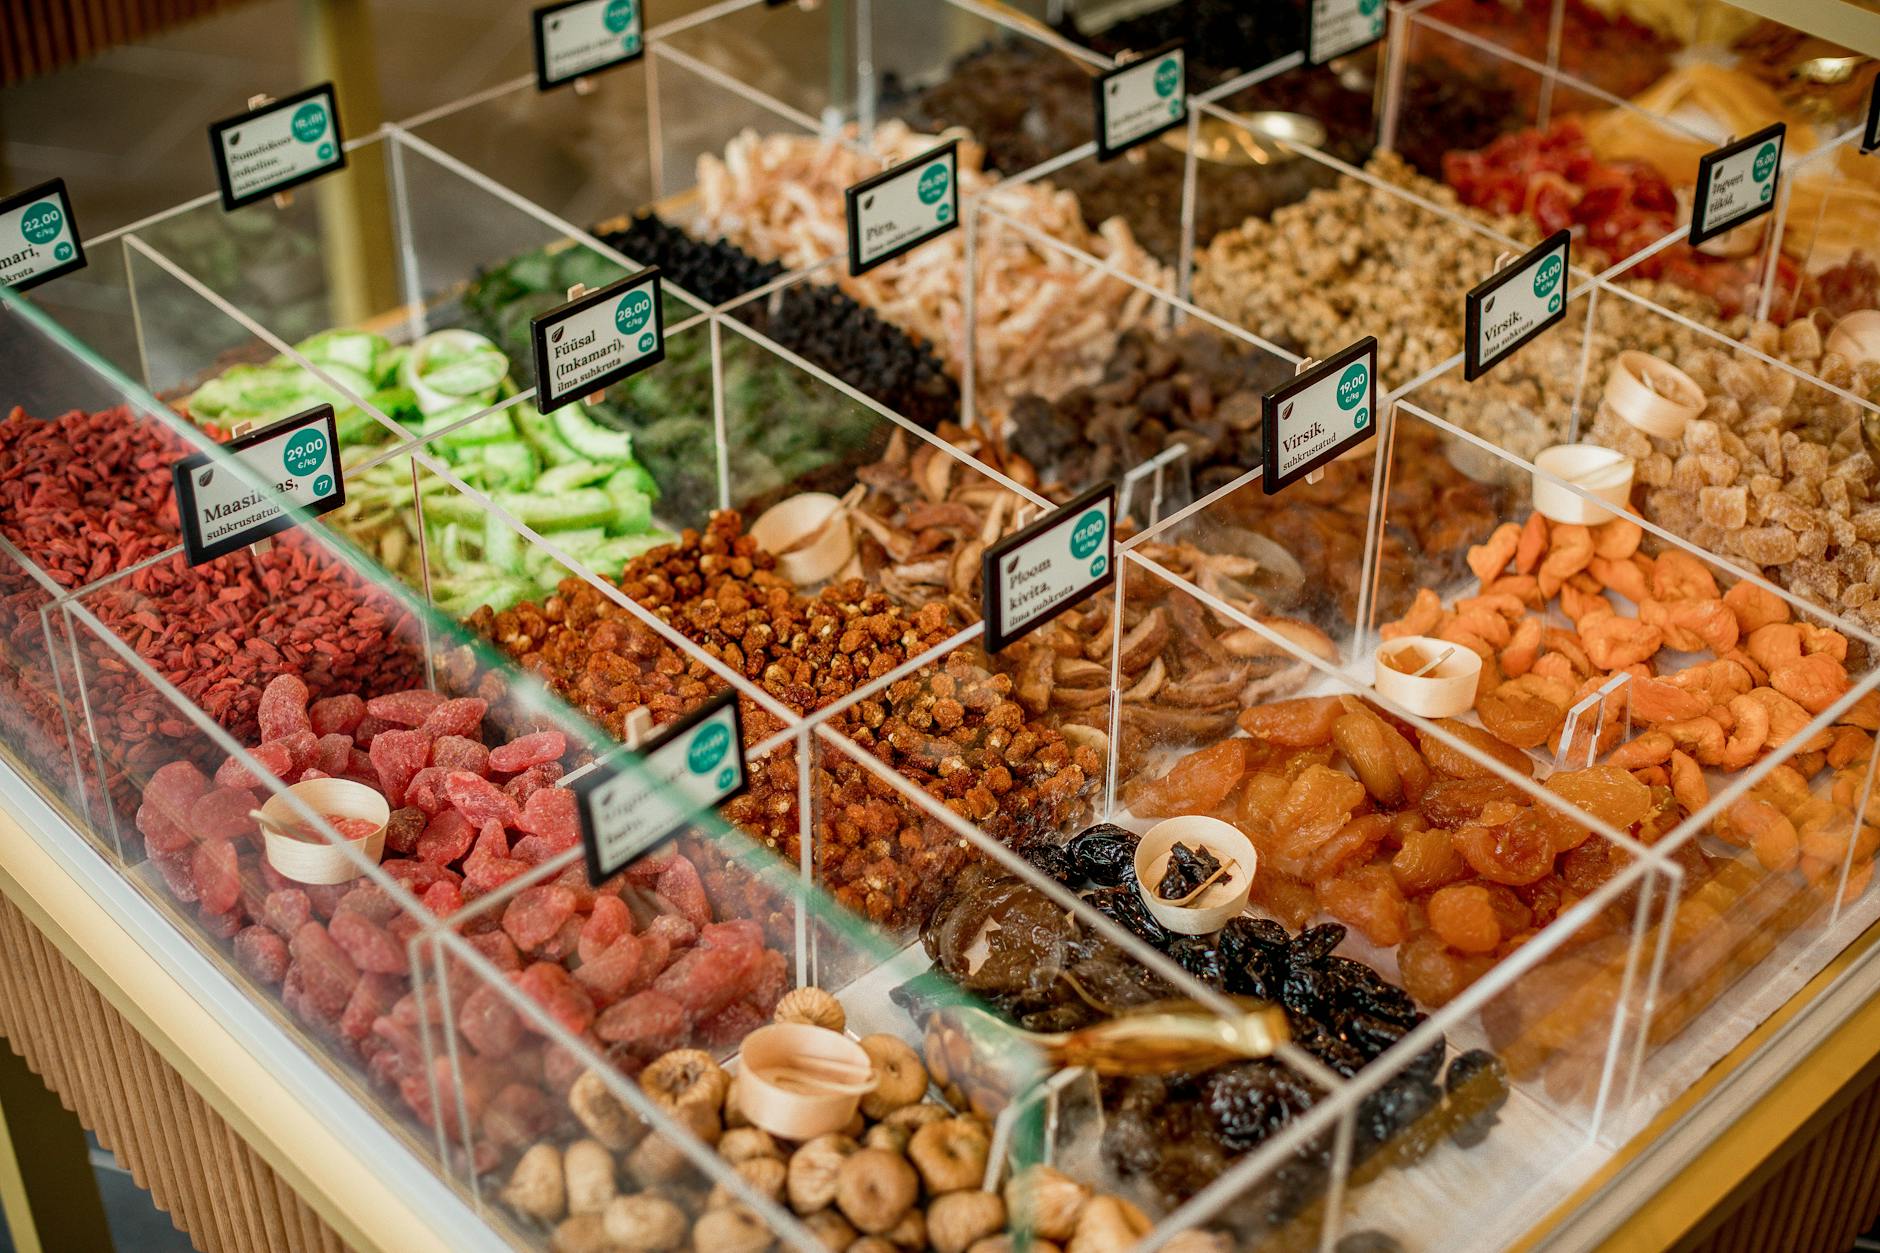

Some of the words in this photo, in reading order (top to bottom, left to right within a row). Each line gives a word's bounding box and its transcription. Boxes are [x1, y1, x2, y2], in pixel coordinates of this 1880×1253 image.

[554, 330, 596, 359] Füüsal
[557, 379, 578, 393] ilma
[580, 358, 622, 382] suhkruta
[1356, 412, 1366, 424] 87
[287, 438, 323, 462] 29,00
[1282, 421, 1325, 454] Virsik,
[1283, 432, 1337, 471] suhkrustatud
[317, 480, 328, 490] 77
[1010, 559, 1052, 589] Ploom
[1009, 612, 1030, 627] ilma
[1033, 585, 1074, 613] suhkruta
